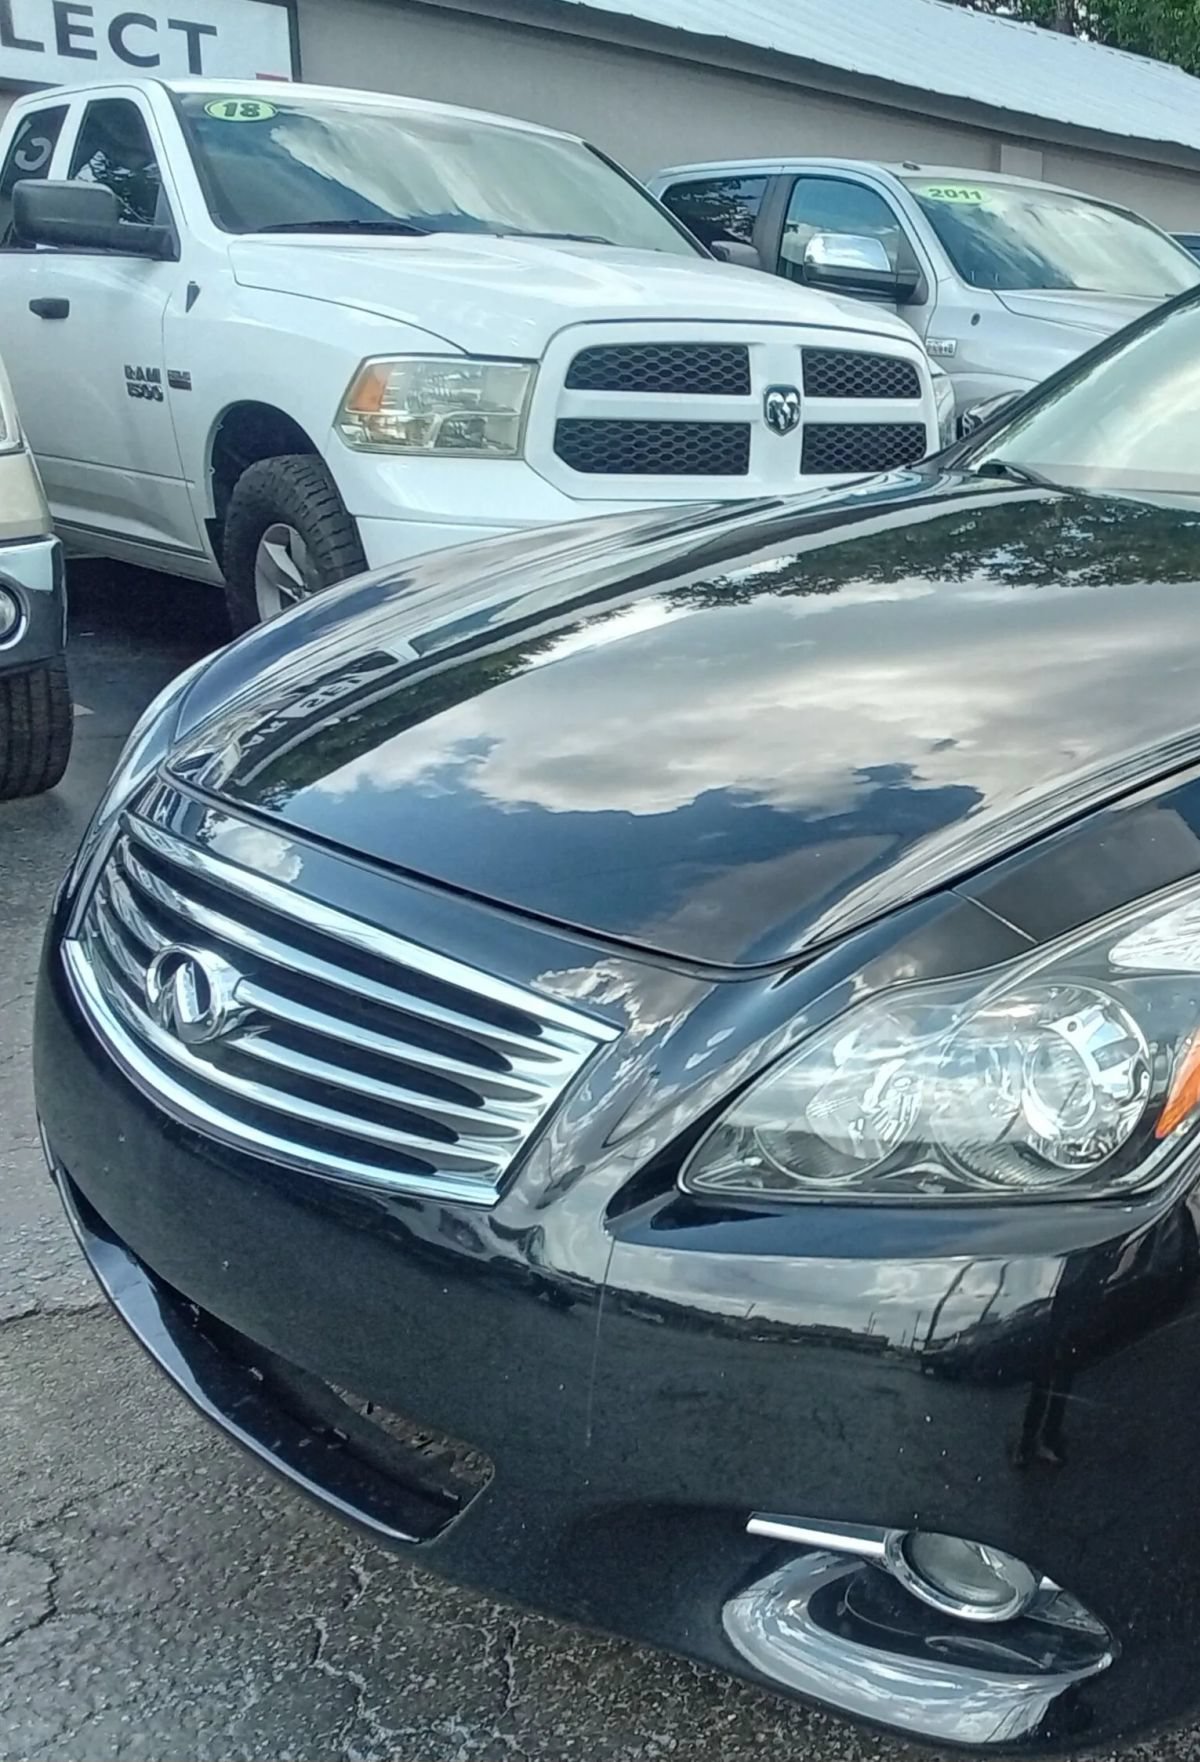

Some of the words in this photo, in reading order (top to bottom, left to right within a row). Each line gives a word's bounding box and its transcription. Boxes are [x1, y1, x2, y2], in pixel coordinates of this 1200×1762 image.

[0, 0, 217, 75] LECT
[222, 102, 261, 117] 18
[928, 188, 982, 200] 2011
[124, 364, 162, 384] RAM
